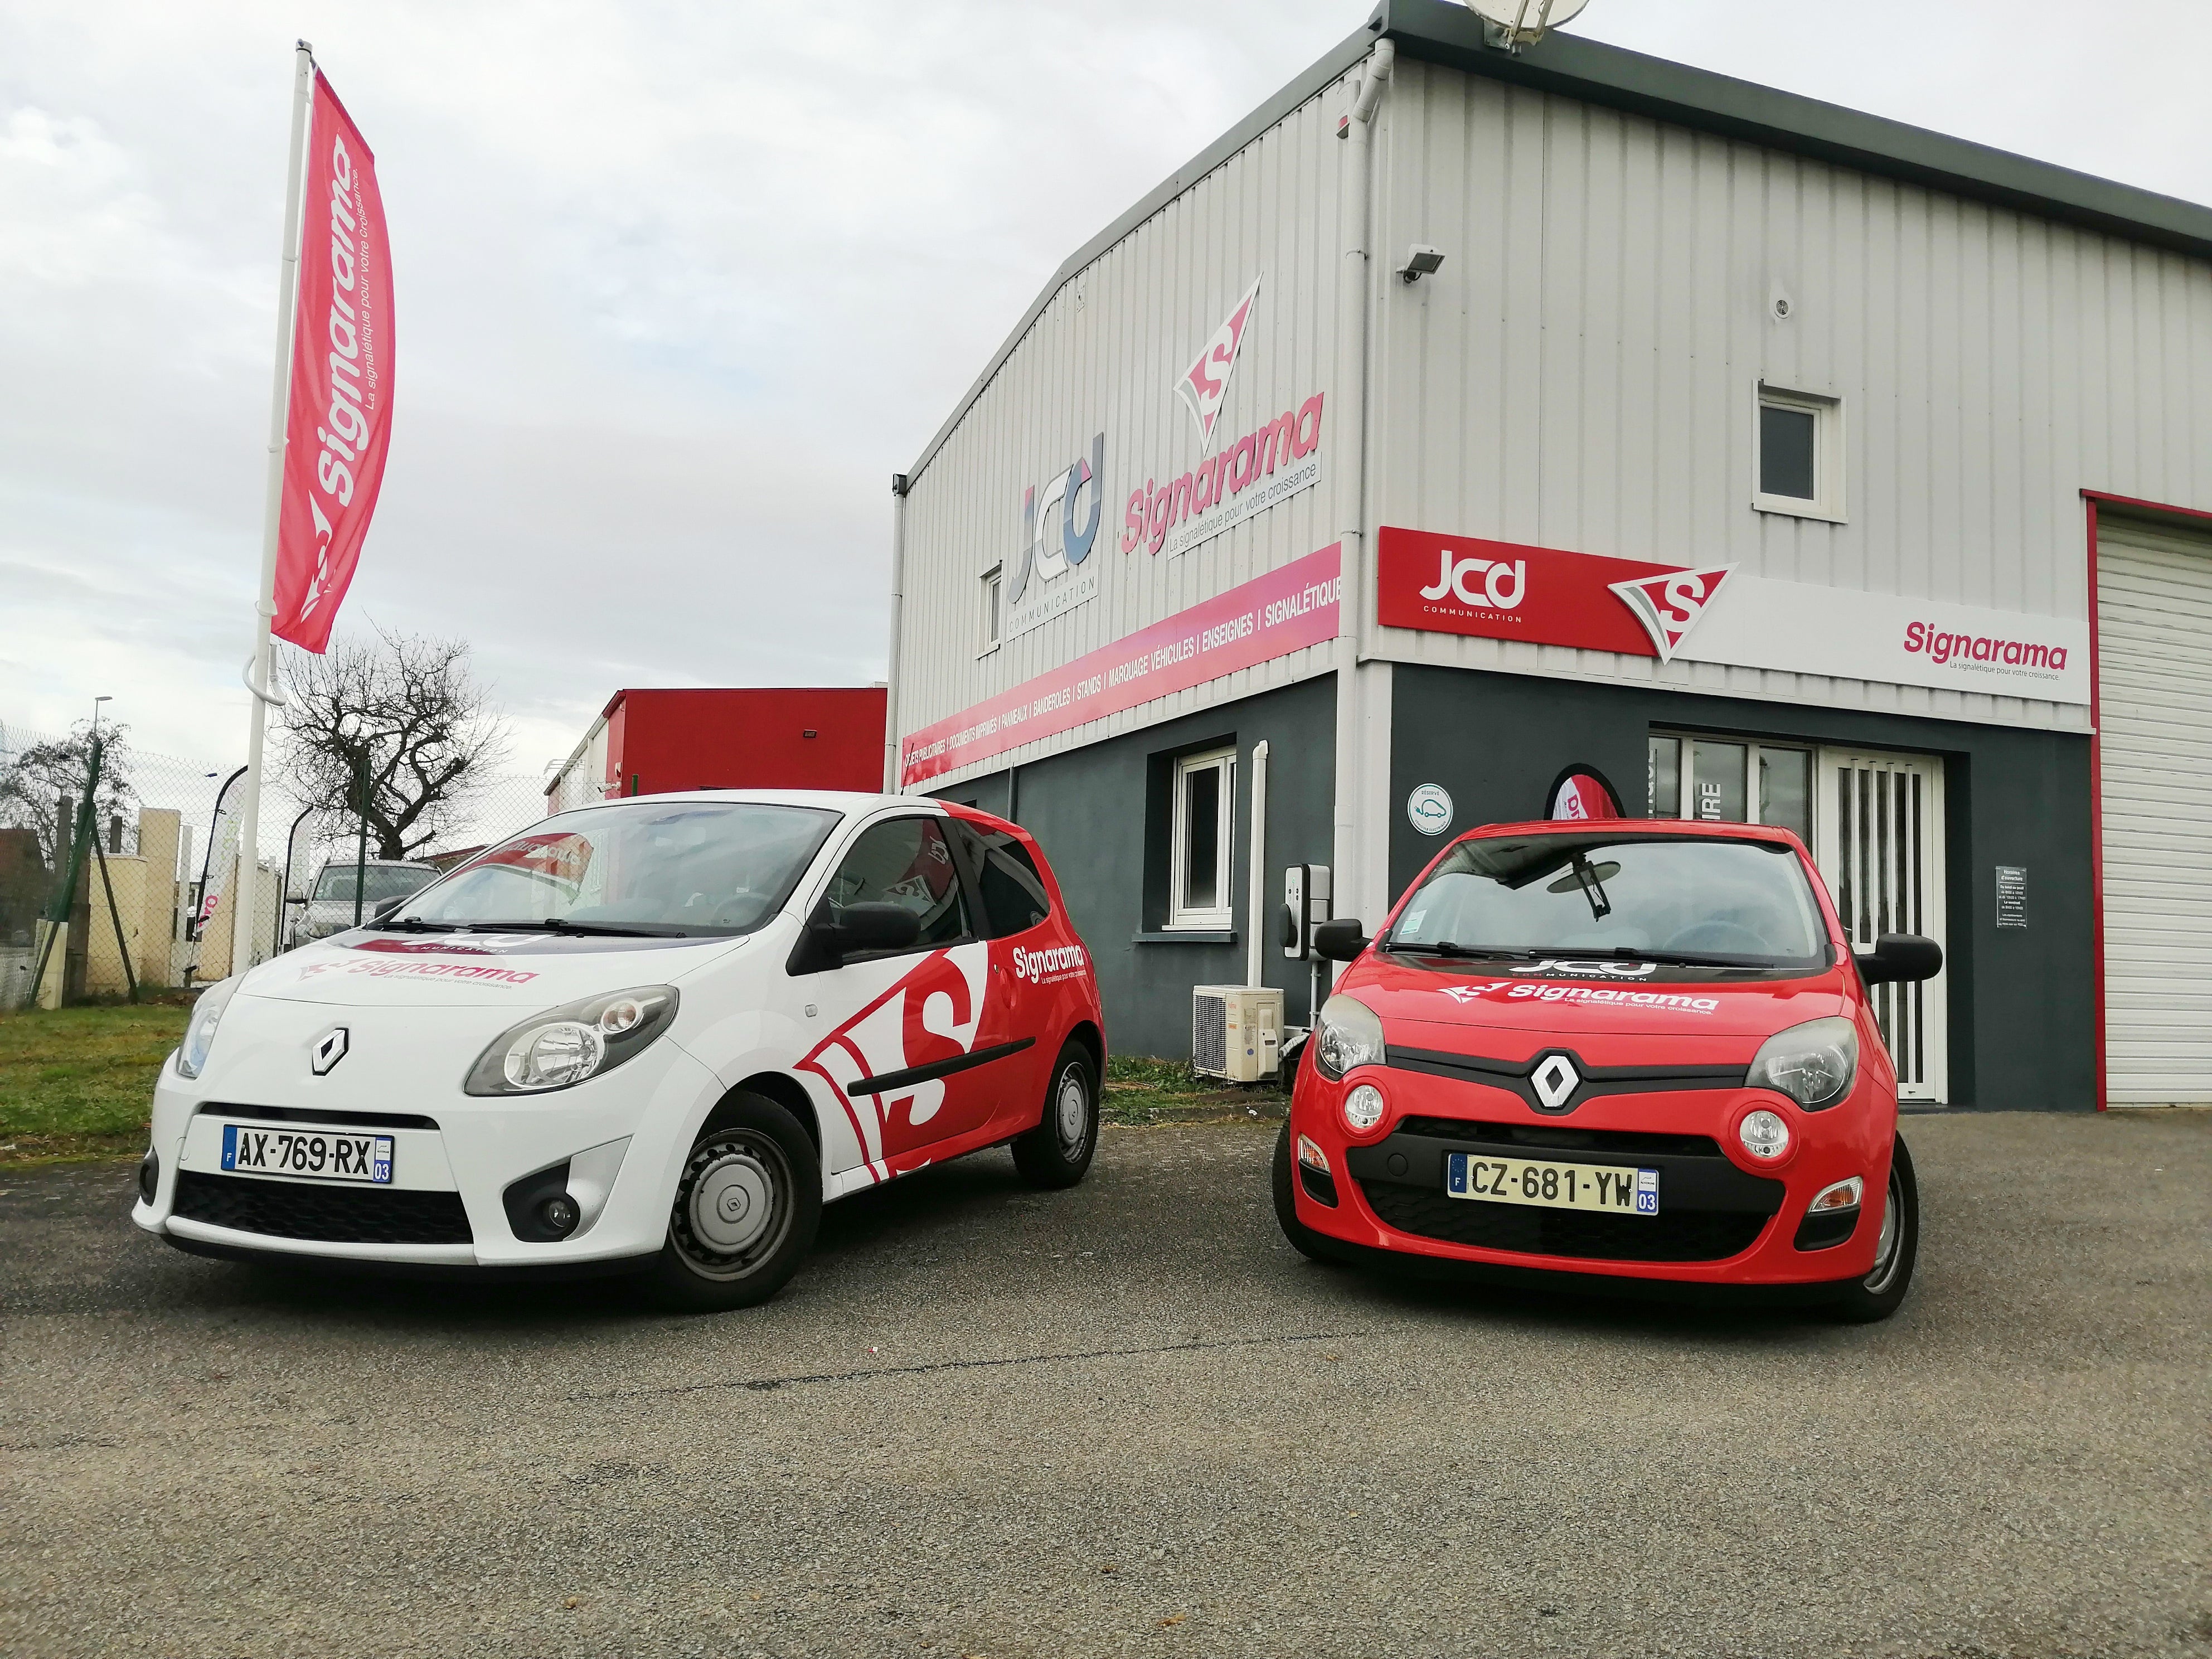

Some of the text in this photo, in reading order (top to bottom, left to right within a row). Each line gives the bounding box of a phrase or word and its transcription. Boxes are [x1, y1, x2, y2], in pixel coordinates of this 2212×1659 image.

[361, 241, 369, 272] votre
[361, 276, 372, 308] pour
[317, 134, 368, 507] Signarama
[361, 311, 378, 389] signalétique
[365, 394, 375, 410] La
[1122, 391, 1324, 555] Signarama
[1170, 464, 1316, 552] La signalétique pour votre croissance
[1009, 576, 1095, 633] COMMUNICATION
[1423, 605, 1522, 623] COMMUNICATION
[1904, 622, 2068, 670] Signarama
[949, 726, 975, 750] DOCUMENTS
[976, 715, 997, 740] IMPRIMÉS
[1002, 706, 1027, 730] PANNEAUX
[1034, 687, 1070, 716] BANDEROLES
[1077, 676, 1101, 701] STANDS
[1109, 654, 1148, 687] MARQUAGE
[1151, 636, 1194, 671] VÉHICULES
[1202, 613, 1253, 652] ENSEIGNES
[1958, 662, 1995, 673] signalétique
[347, 960, 540, 983] Signarama
[1013, 945, 1084, 984] Signarama
[1507, 984, 1720, 1010] Signarama
[226, 1152, 232, 1162] F
[238, 1133, 370, 1175] AX-769-RX
[375, 1163, 389, 1180] 03
[1455, 1177, 1461, 1186] F
[1472, 1162, 1632, 1207] CZ-681-YW
[1638, 1194, 1656, 1210] 03
